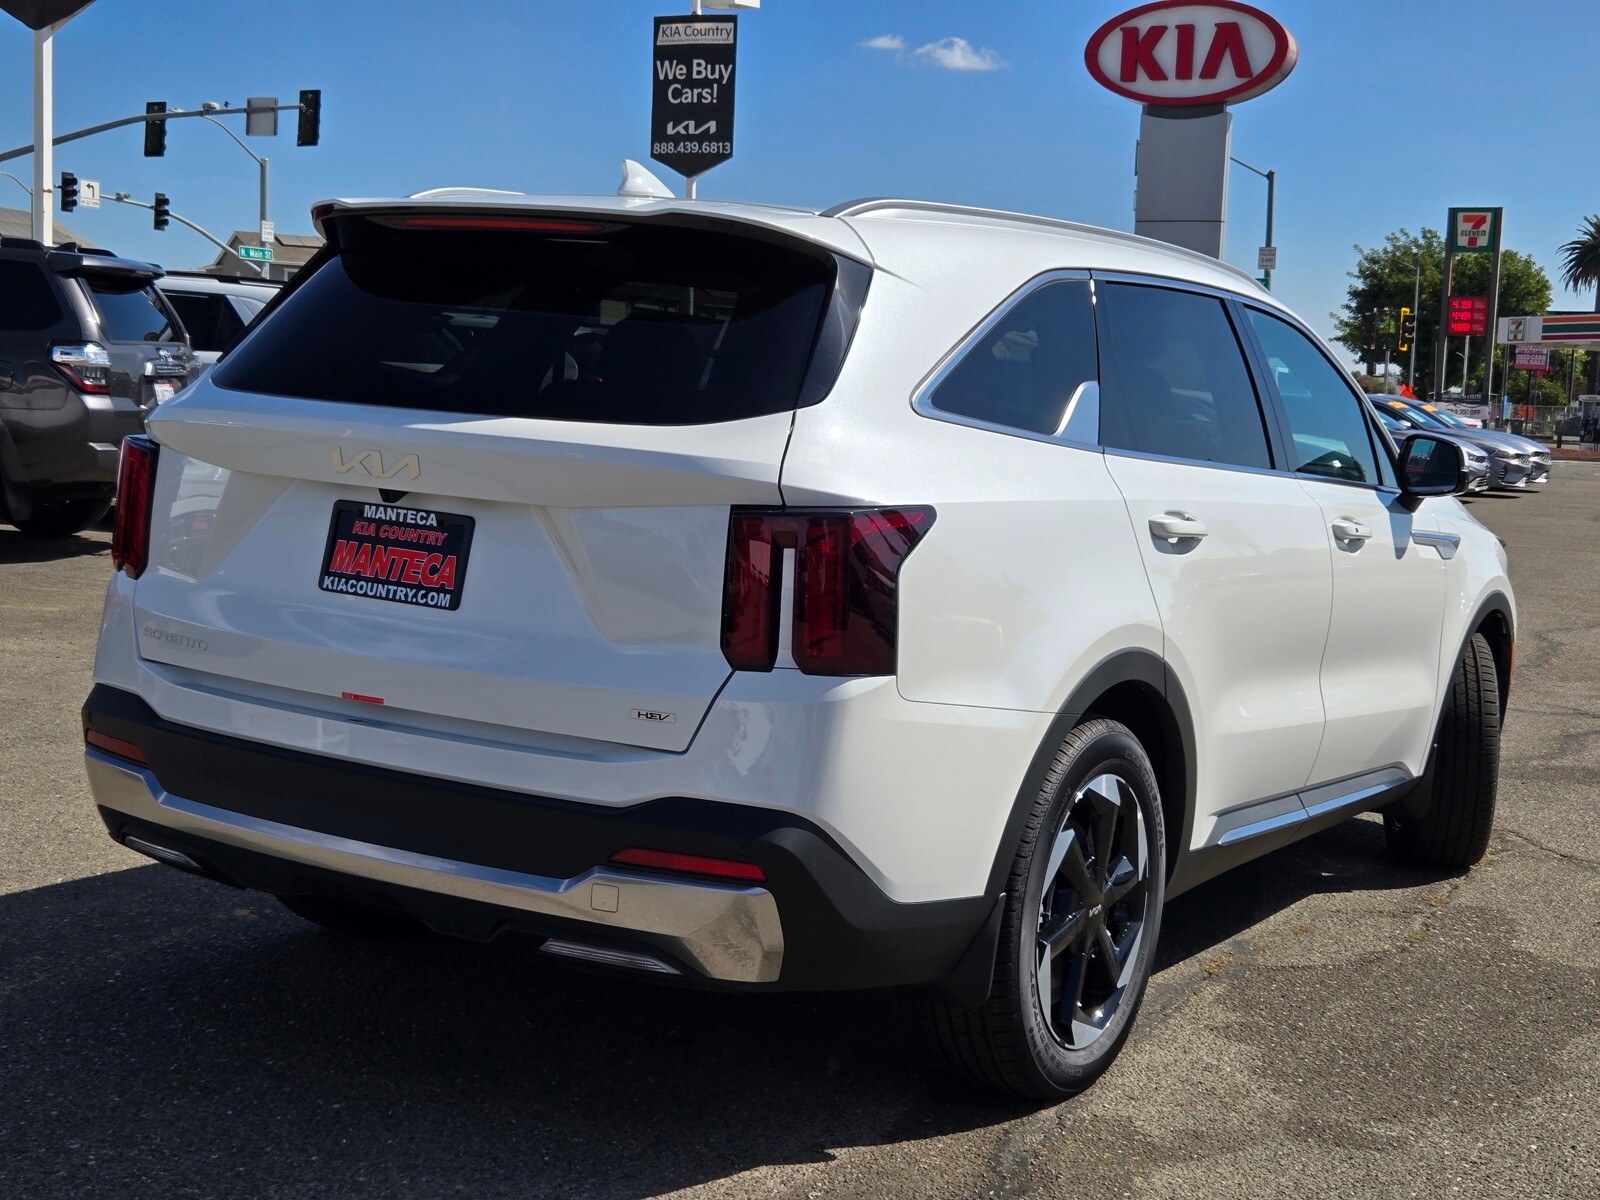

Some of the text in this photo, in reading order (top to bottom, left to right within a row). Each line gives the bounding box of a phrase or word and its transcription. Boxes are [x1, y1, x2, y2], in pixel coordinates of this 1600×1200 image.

[661, 25, 732, 40] KIA Country
[1120, 22, 1252, 82] KIA
[656, 59, 733, 84] We Buy
[668, 84, 718, 104] Cars!
[667, 120, 717, 135] KIA
[653, 142, 731, 155] 888.439.6813
[1462, 214, 1487, 247] 7
[241, 248, 272, 260] N. Main St
[331, 445, 422, 481] KIA
[364, 504, 438, 527] MANTECA
[352, 521, 448, 546] KIA COUNTRY
[329, 539, 457, 590] MANTECA
[323, 575, 451, 608] KIACOUNTRY.COM
